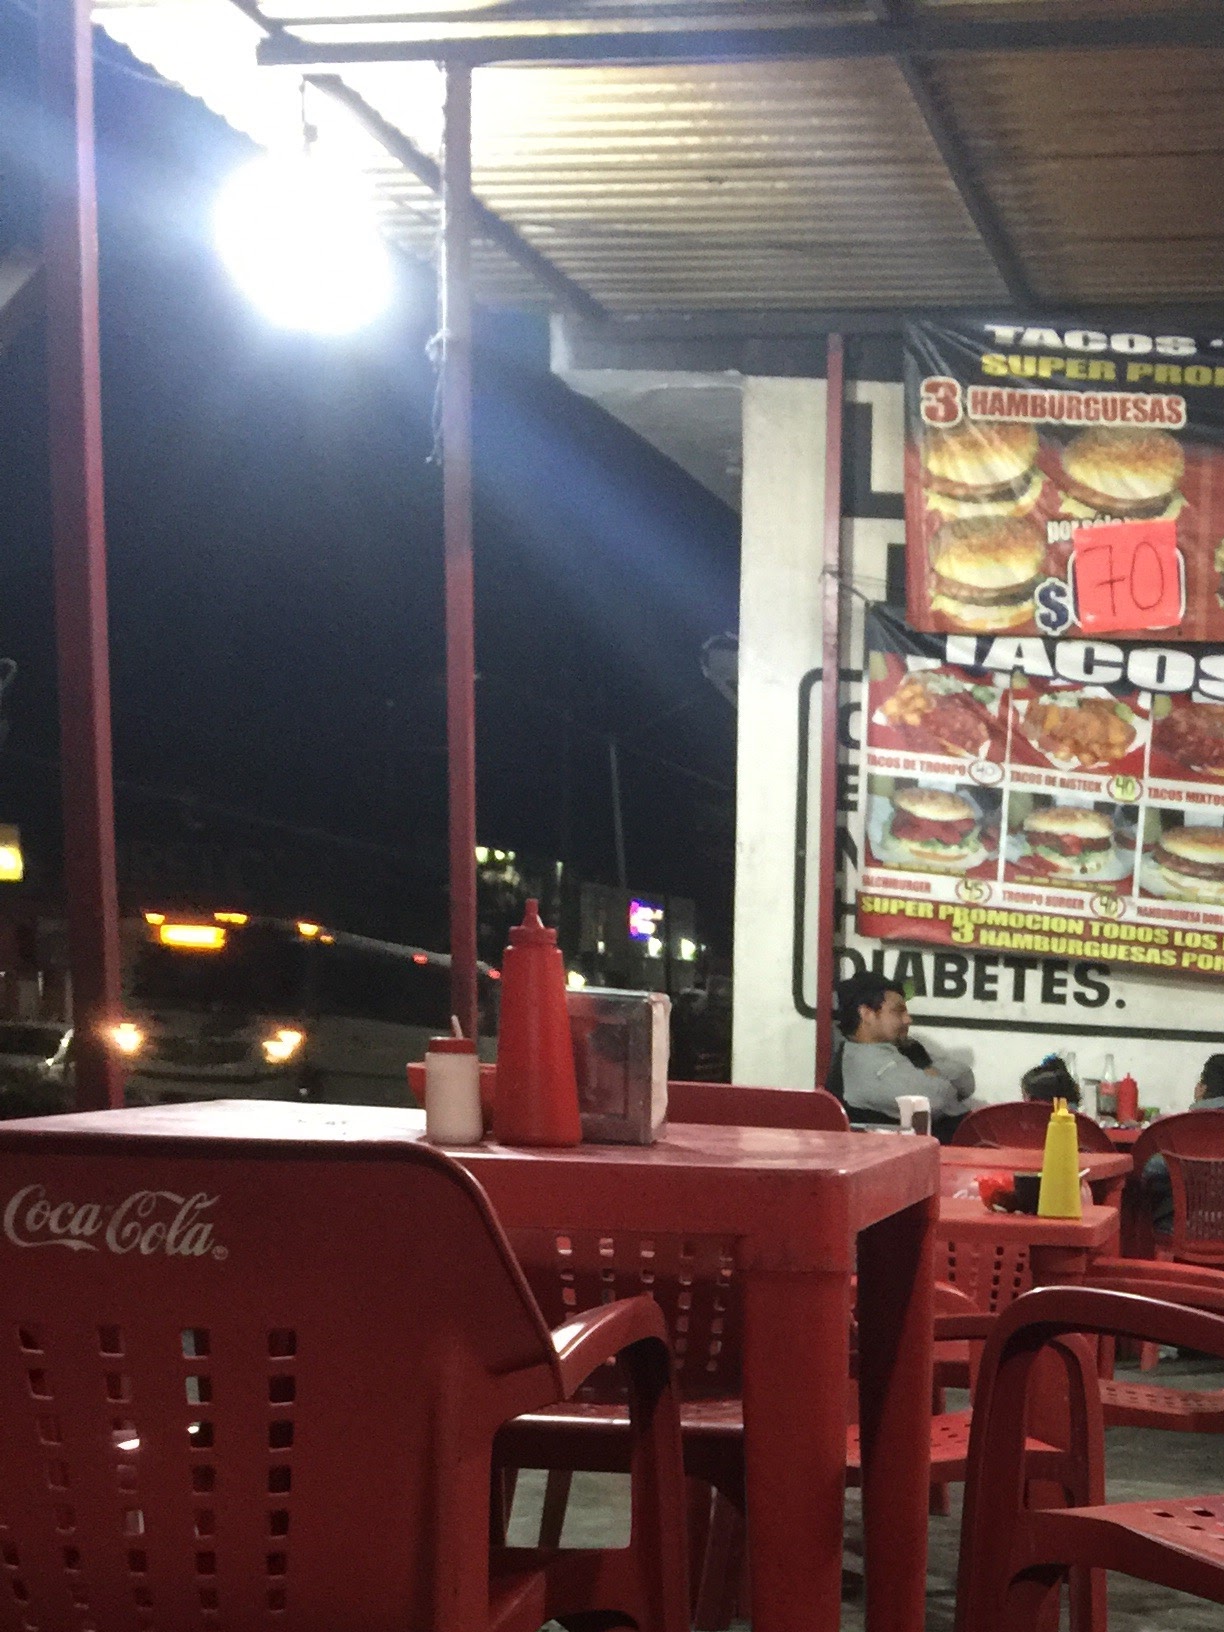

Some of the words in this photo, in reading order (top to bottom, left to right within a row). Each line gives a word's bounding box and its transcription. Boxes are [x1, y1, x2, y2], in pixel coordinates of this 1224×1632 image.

[984, 324, 1197, 355] TACOS
[981, 352, 1117, 382] SUPER
[921, 376, 962, 428] 3
[969, 388, 1185, 426] HAMBURGUESAS
[1083, 541, 1165, 617] 70
[1148, 787, 1183, 802] TACOS
[861, 896, 934, 919] SUPER
[938, 904, 1085, 936] PROMOCION
[1091, 920, 1169, 945] TODOS
[1173, 931, 1218, 950] LOS
[952, 921, 975, 944] 3
[979, 928, 1177, 967] HAMBURGUESAS
